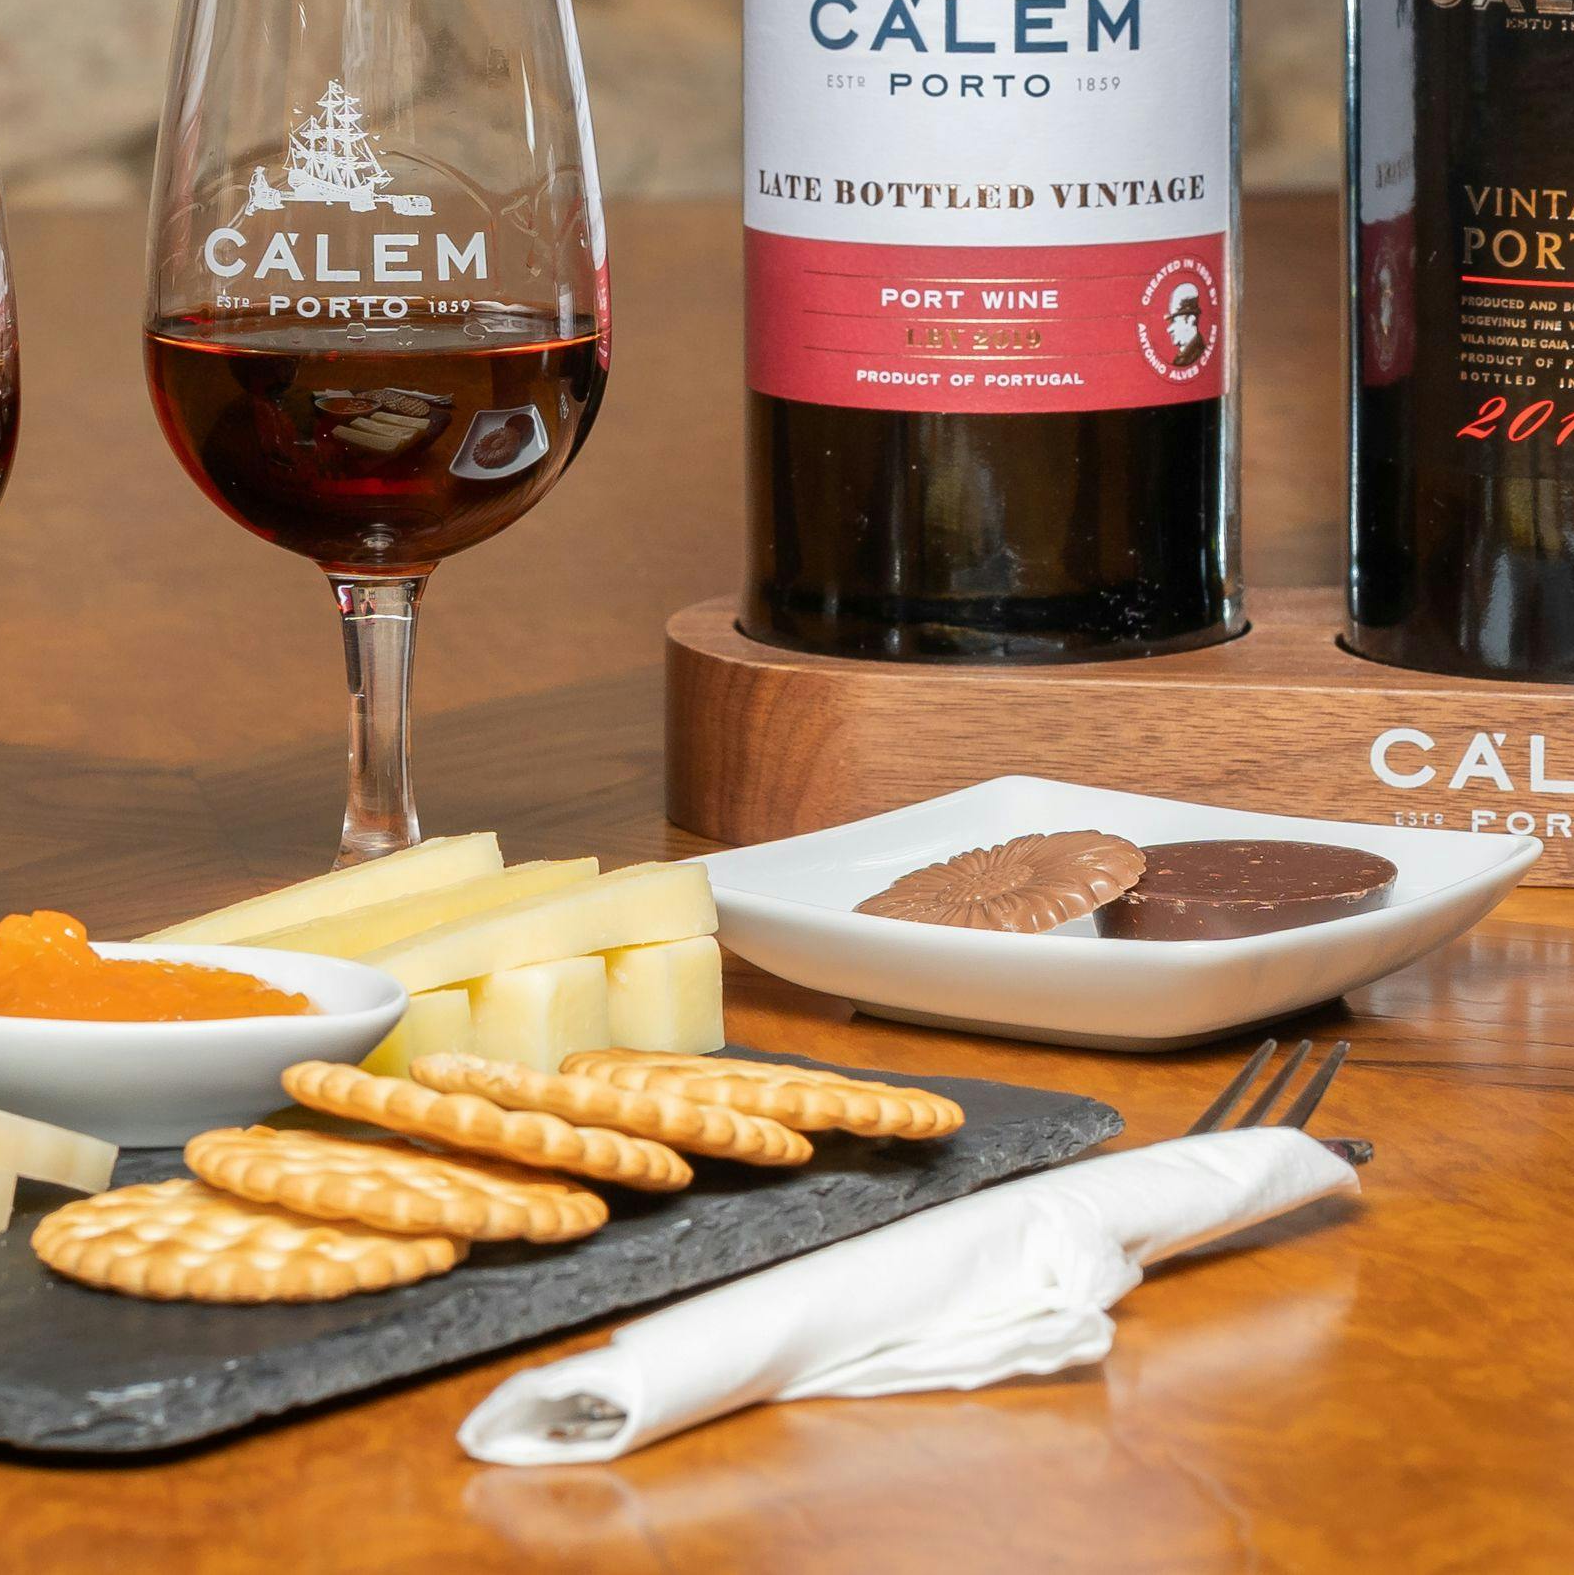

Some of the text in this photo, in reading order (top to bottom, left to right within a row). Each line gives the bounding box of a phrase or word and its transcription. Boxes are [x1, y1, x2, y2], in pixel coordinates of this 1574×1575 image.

[890, 73, 1051, 98] PORTO
[1076, 77, 1122, 92] 1859
[758, 169, 1206, 210] LATE BOTTLED VINTAGE
[1141, 259, 1181, 305] CREATED
[269, 295, 409, 319] PORTO
[427, 300, 471, 314] 1859
[881, 288, 1059, 309] PORT WINE
[1461, 294, 1525, 310] PRODUCED
[1529, 300, 1558, 311] AND
[1461, 314, 1527, 330] SOGEVINUS
[1533, 319, 1563, 332] FINE
[972, 328, 1043, 351] 2019
[1460, 333, 1485, 345] VILA
[1487, 335, 1519, 347] NOVA
[1521, 337, 1537, 349] DE
[1539, 339, 1569, 351] GAIA
[1460, 351, 1524, 367] PRODUCT
[1535, 357, 1555, 369] OF
[856, 369, 1084, 387] PRODUCT OF PORTUGAL
[1169, 364, 1200, 381] ALVES
[1460, 371, 1537, 386] BOTTLED
